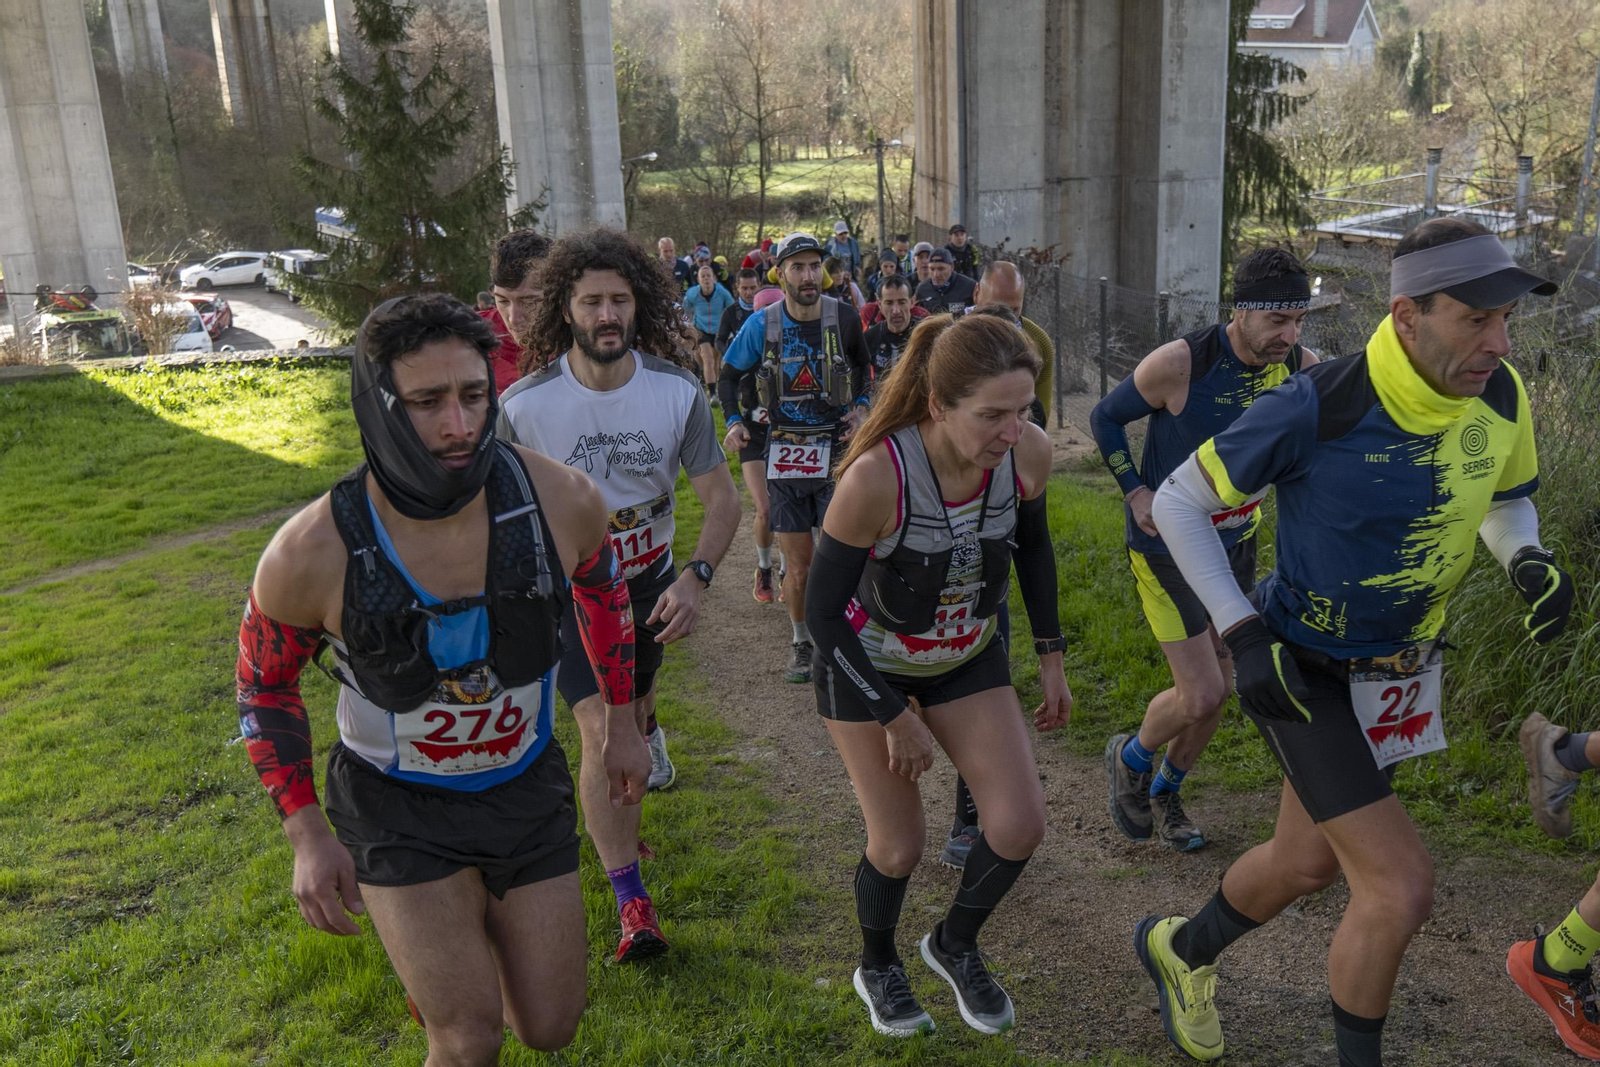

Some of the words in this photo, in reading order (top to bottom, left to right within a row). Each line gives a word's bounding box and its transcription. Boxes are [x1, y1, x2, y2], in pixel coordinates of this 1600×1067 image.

[1215, 397, 1232, 405] TACTIC
[605, 430, 662, 479] Montes
[778, 447, 819, 465] 224
[1365, 454, 1390, 462] TACTIC
[1462, 457, 1495, 475] SERRES
[612, 527, 652, 561] 111
[1377, 681, 1421, 724] 22
[424, 695, 523, 743] 276
